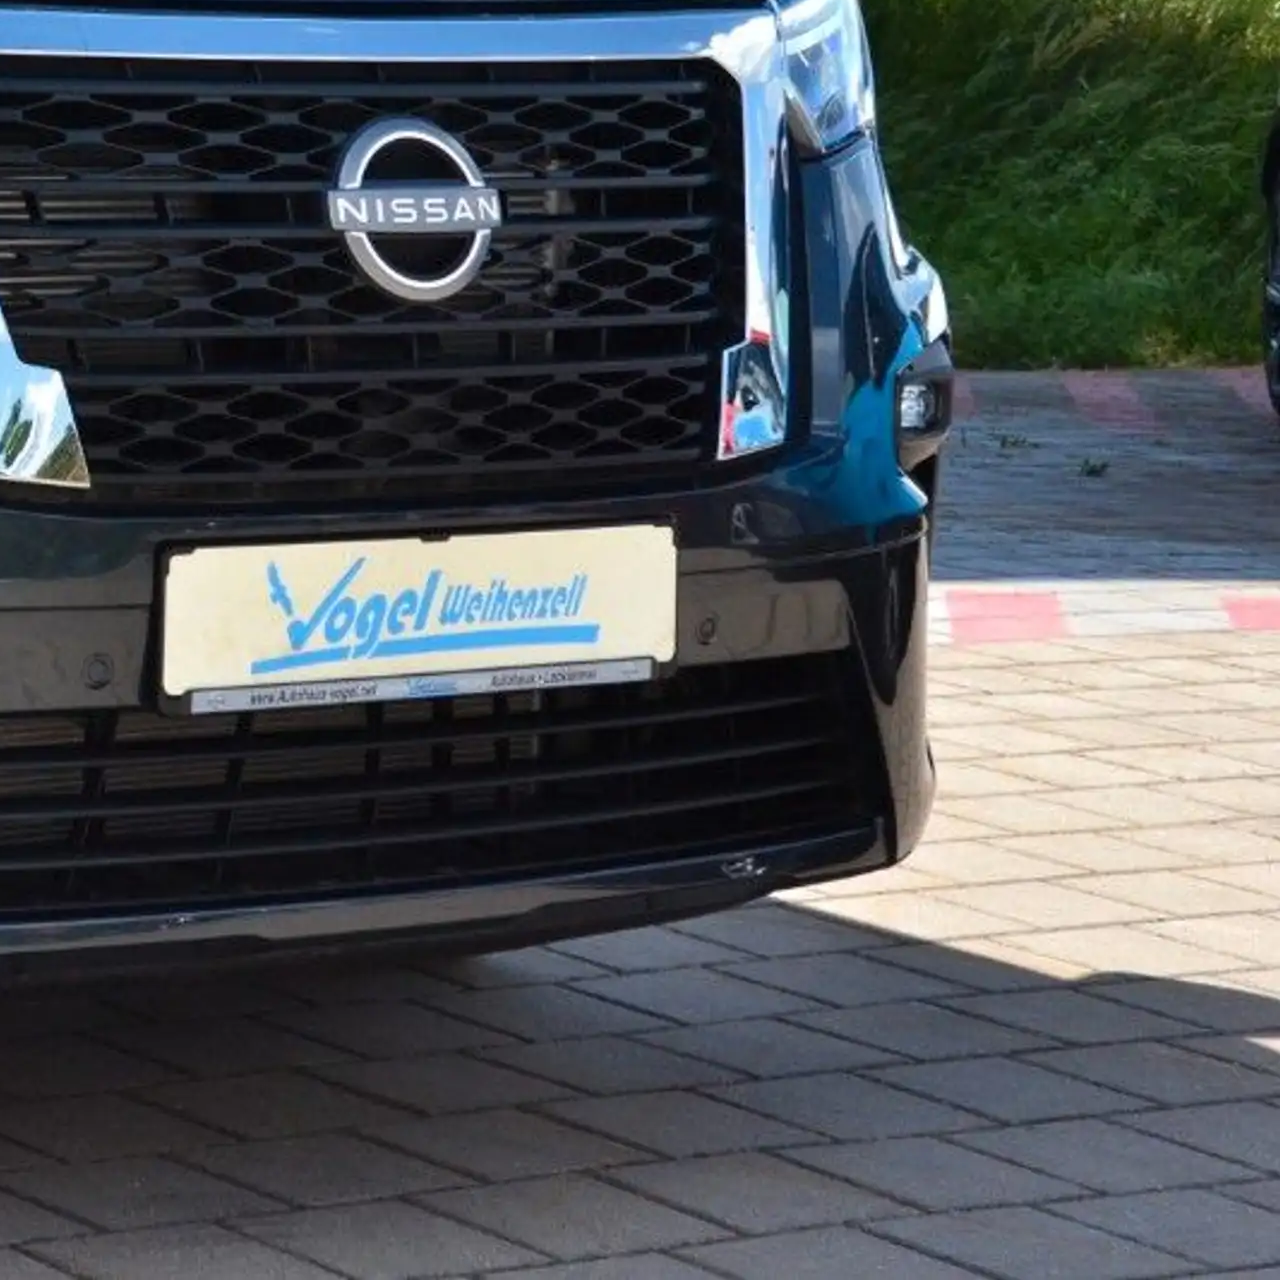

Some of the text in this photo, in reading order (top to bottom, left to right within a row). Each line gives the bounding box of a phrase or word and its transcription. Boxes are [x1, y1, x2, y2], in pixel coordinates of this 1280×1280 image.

[336, 197, 501, 224] NISSAN
[267, 556, 588, 660] Vogel Weihenzell
